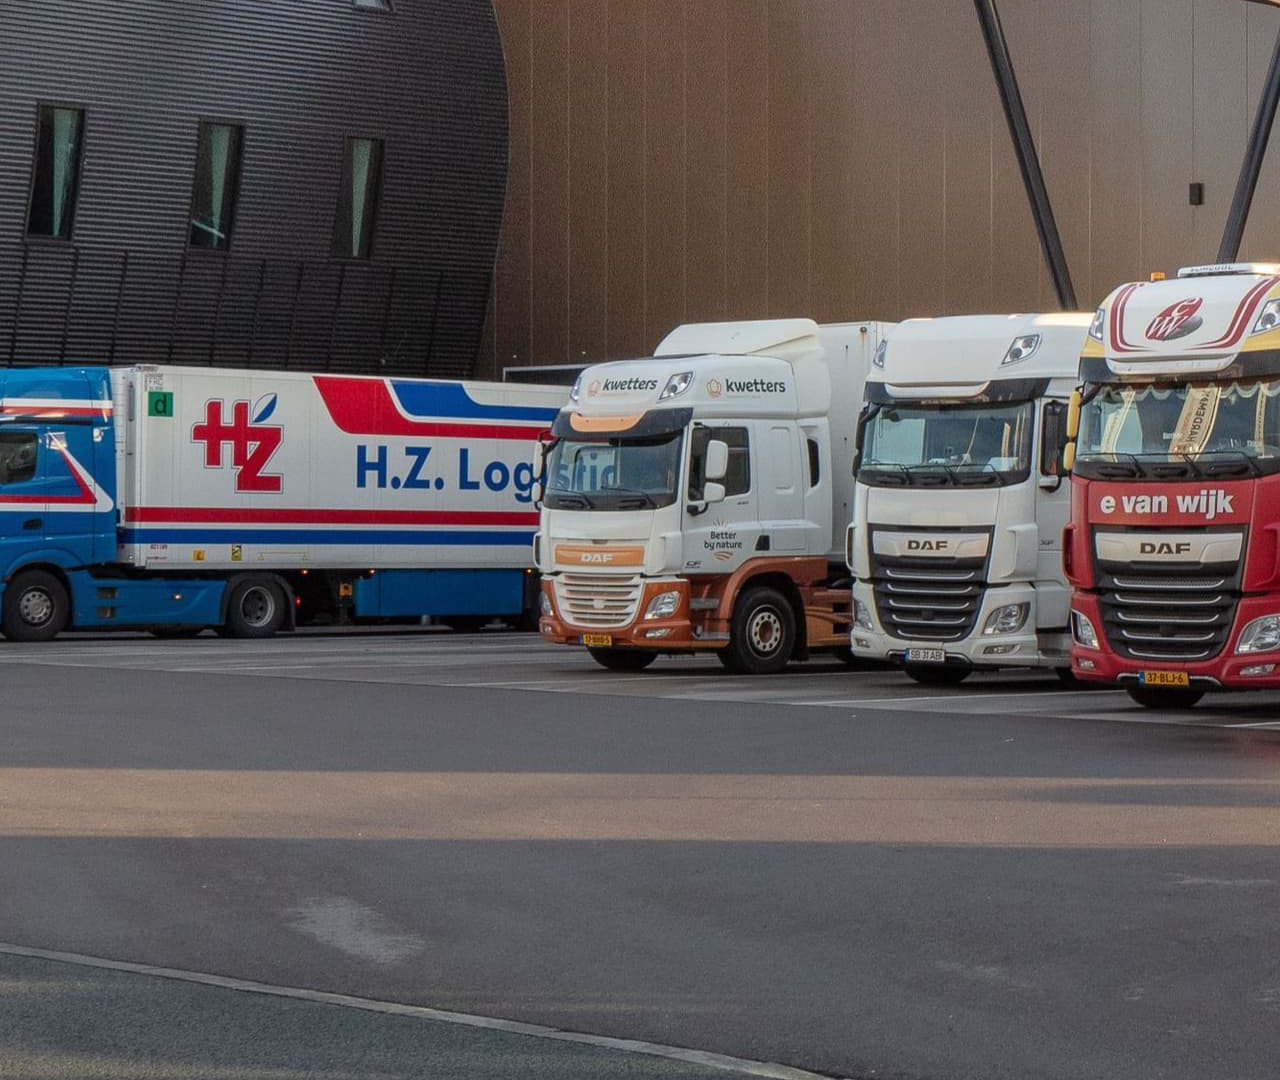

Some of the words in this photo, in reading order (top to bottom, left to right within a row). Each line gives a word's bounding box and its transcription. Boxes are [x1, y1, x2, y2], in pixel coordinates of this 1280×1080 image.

[602, 377, 659, 391] kwetters
[725, 378, 786, 393] kwetters
[356, 445, 445, 491] H.Z.
[1100, 495, 1116, 514] e
[1122, 495, 1168, 514] van
[1176, 489, 1234, 520] wijk
[710, 530, 737, 540] Better
[703, 540, 715, 550] by
[715, 540, 742, 549] nature
[907, 540, 948, 551] DAF
[1139, 542, 1191, 555] DAF
[580, 553, 613, 562] DAF
